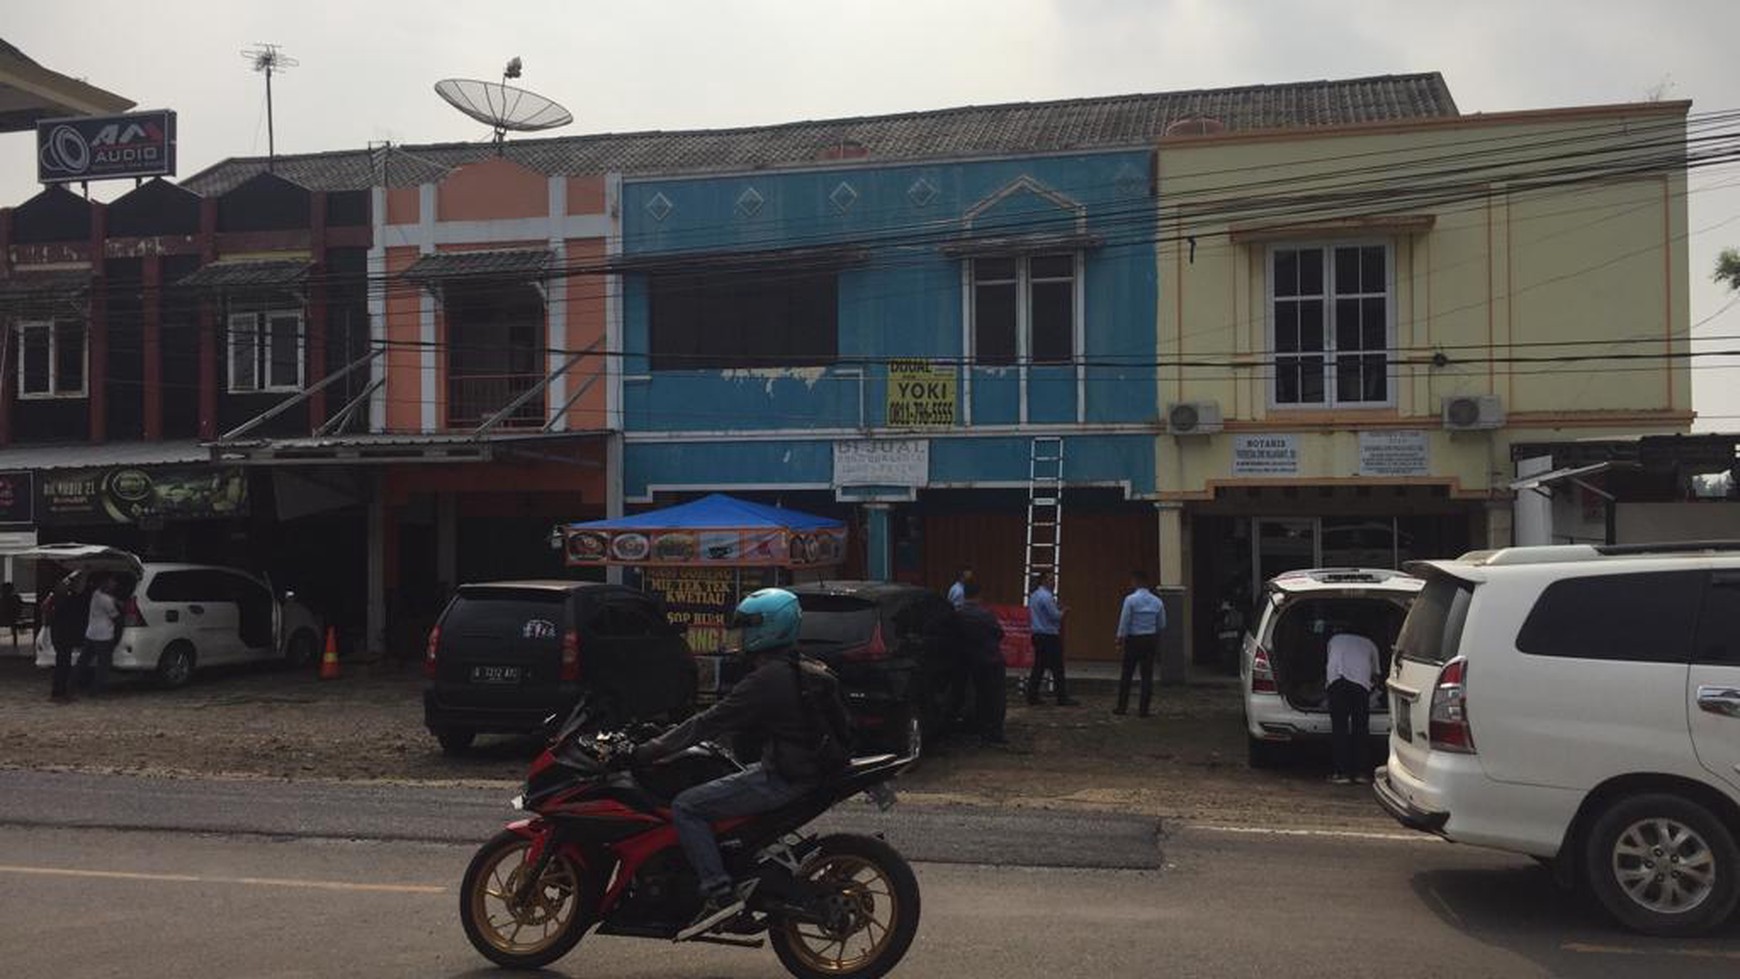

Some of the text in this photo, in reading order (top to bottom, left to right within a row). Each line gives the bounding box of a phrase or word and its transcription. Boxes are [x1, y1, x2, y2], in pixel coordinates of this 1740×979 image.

[95, 147, 157, 163] AUDIO
[898, 383, 947, 399] YOKI
[666, 591, 725, 605] KWETIAU
